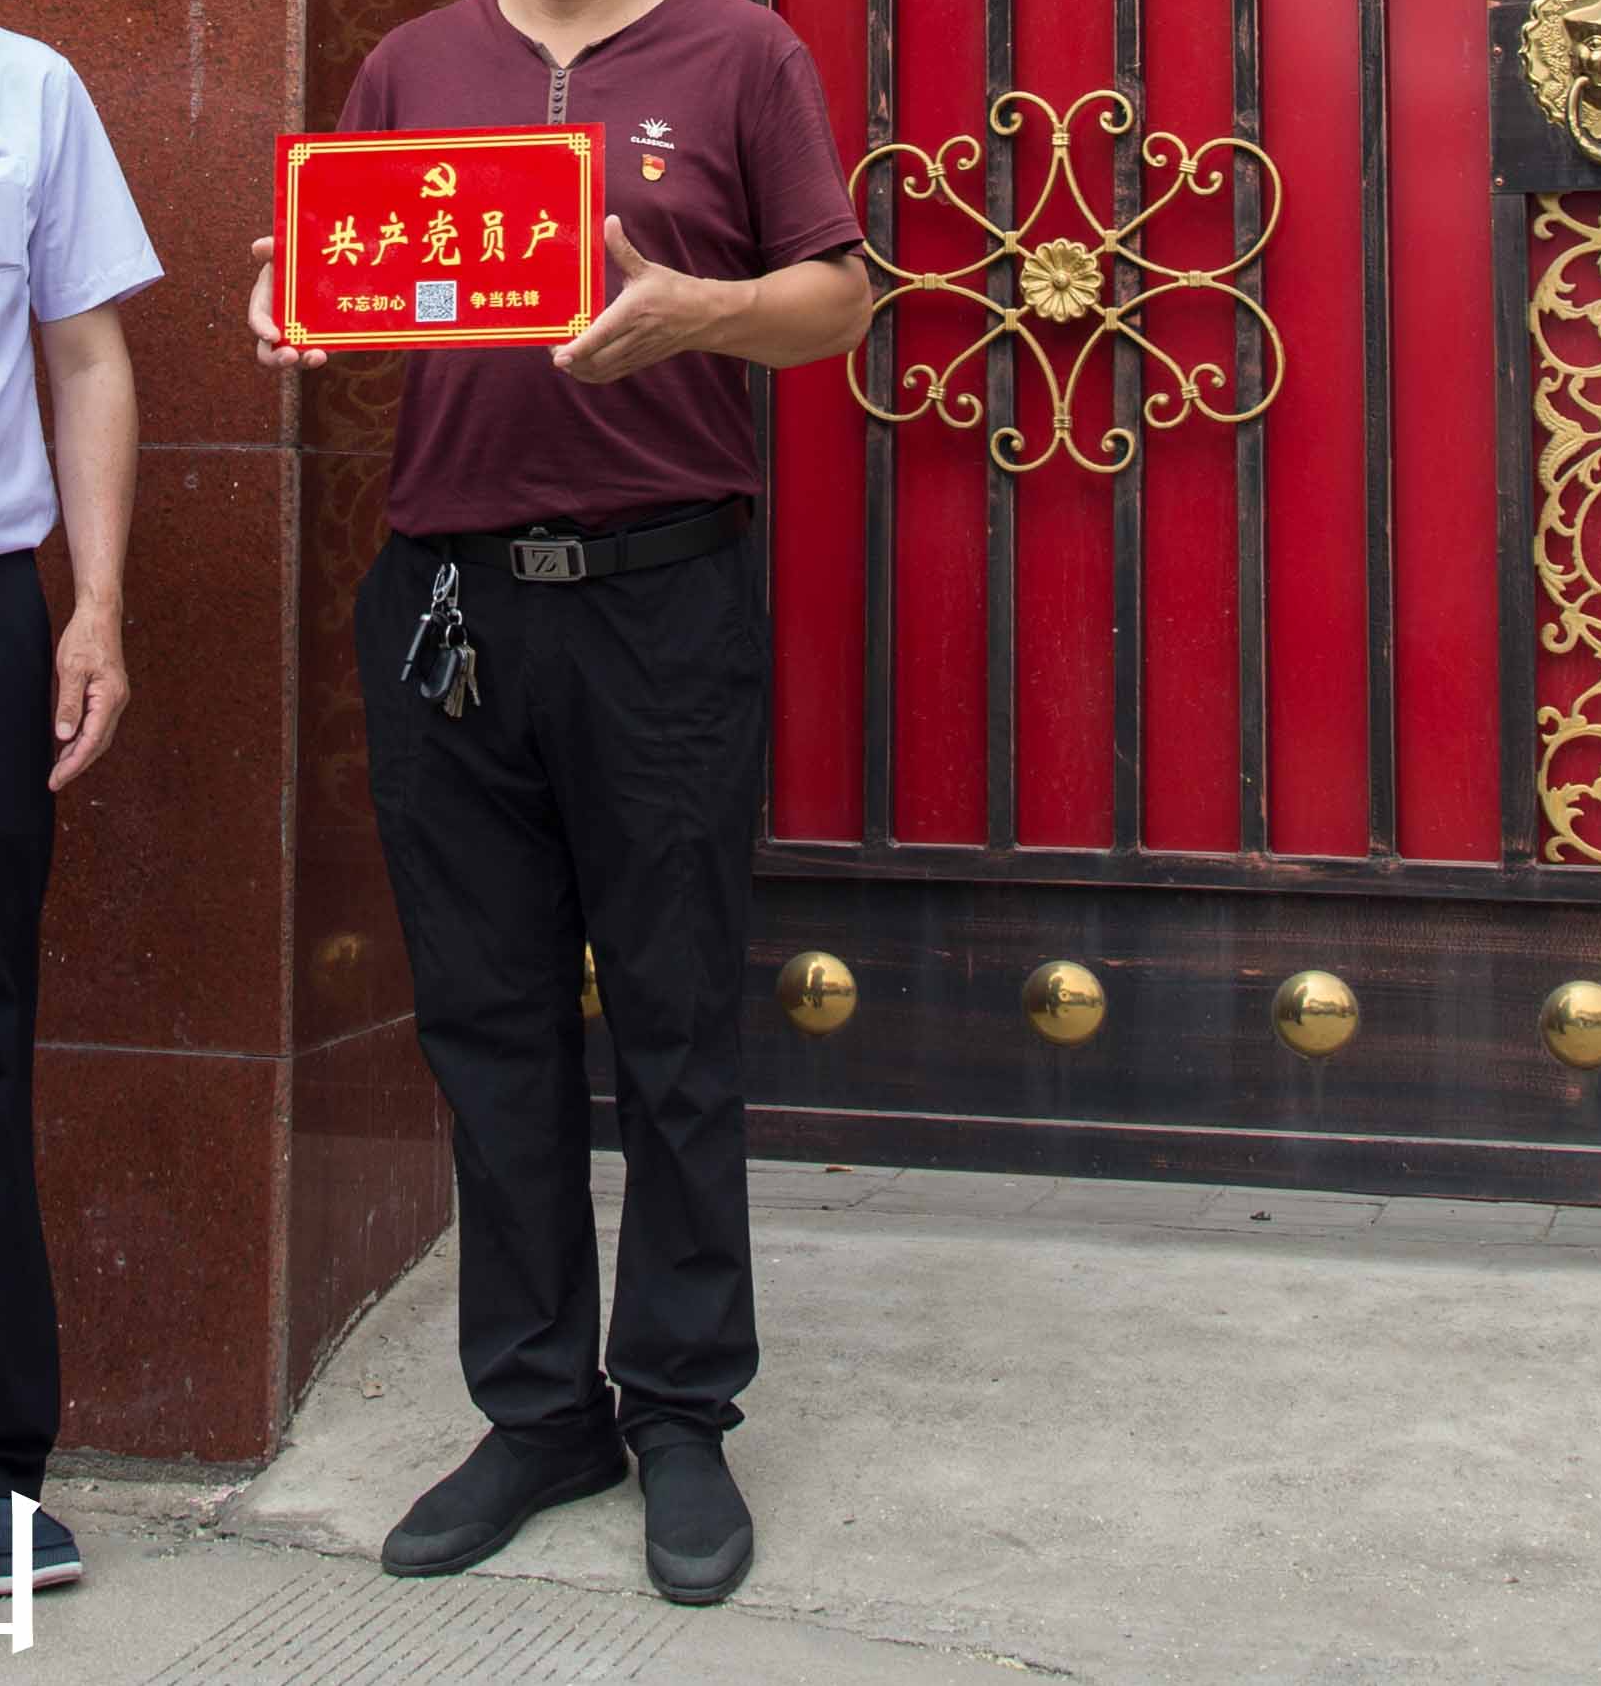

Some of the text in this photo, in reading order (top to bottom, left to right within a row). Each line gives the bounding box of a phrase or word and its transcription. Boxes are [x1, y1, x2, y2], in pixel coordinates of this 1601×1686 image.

[321, 209, 559, 267] 共产党员户
[337, 289, 540, 312] 不忘初心 争当先锋
